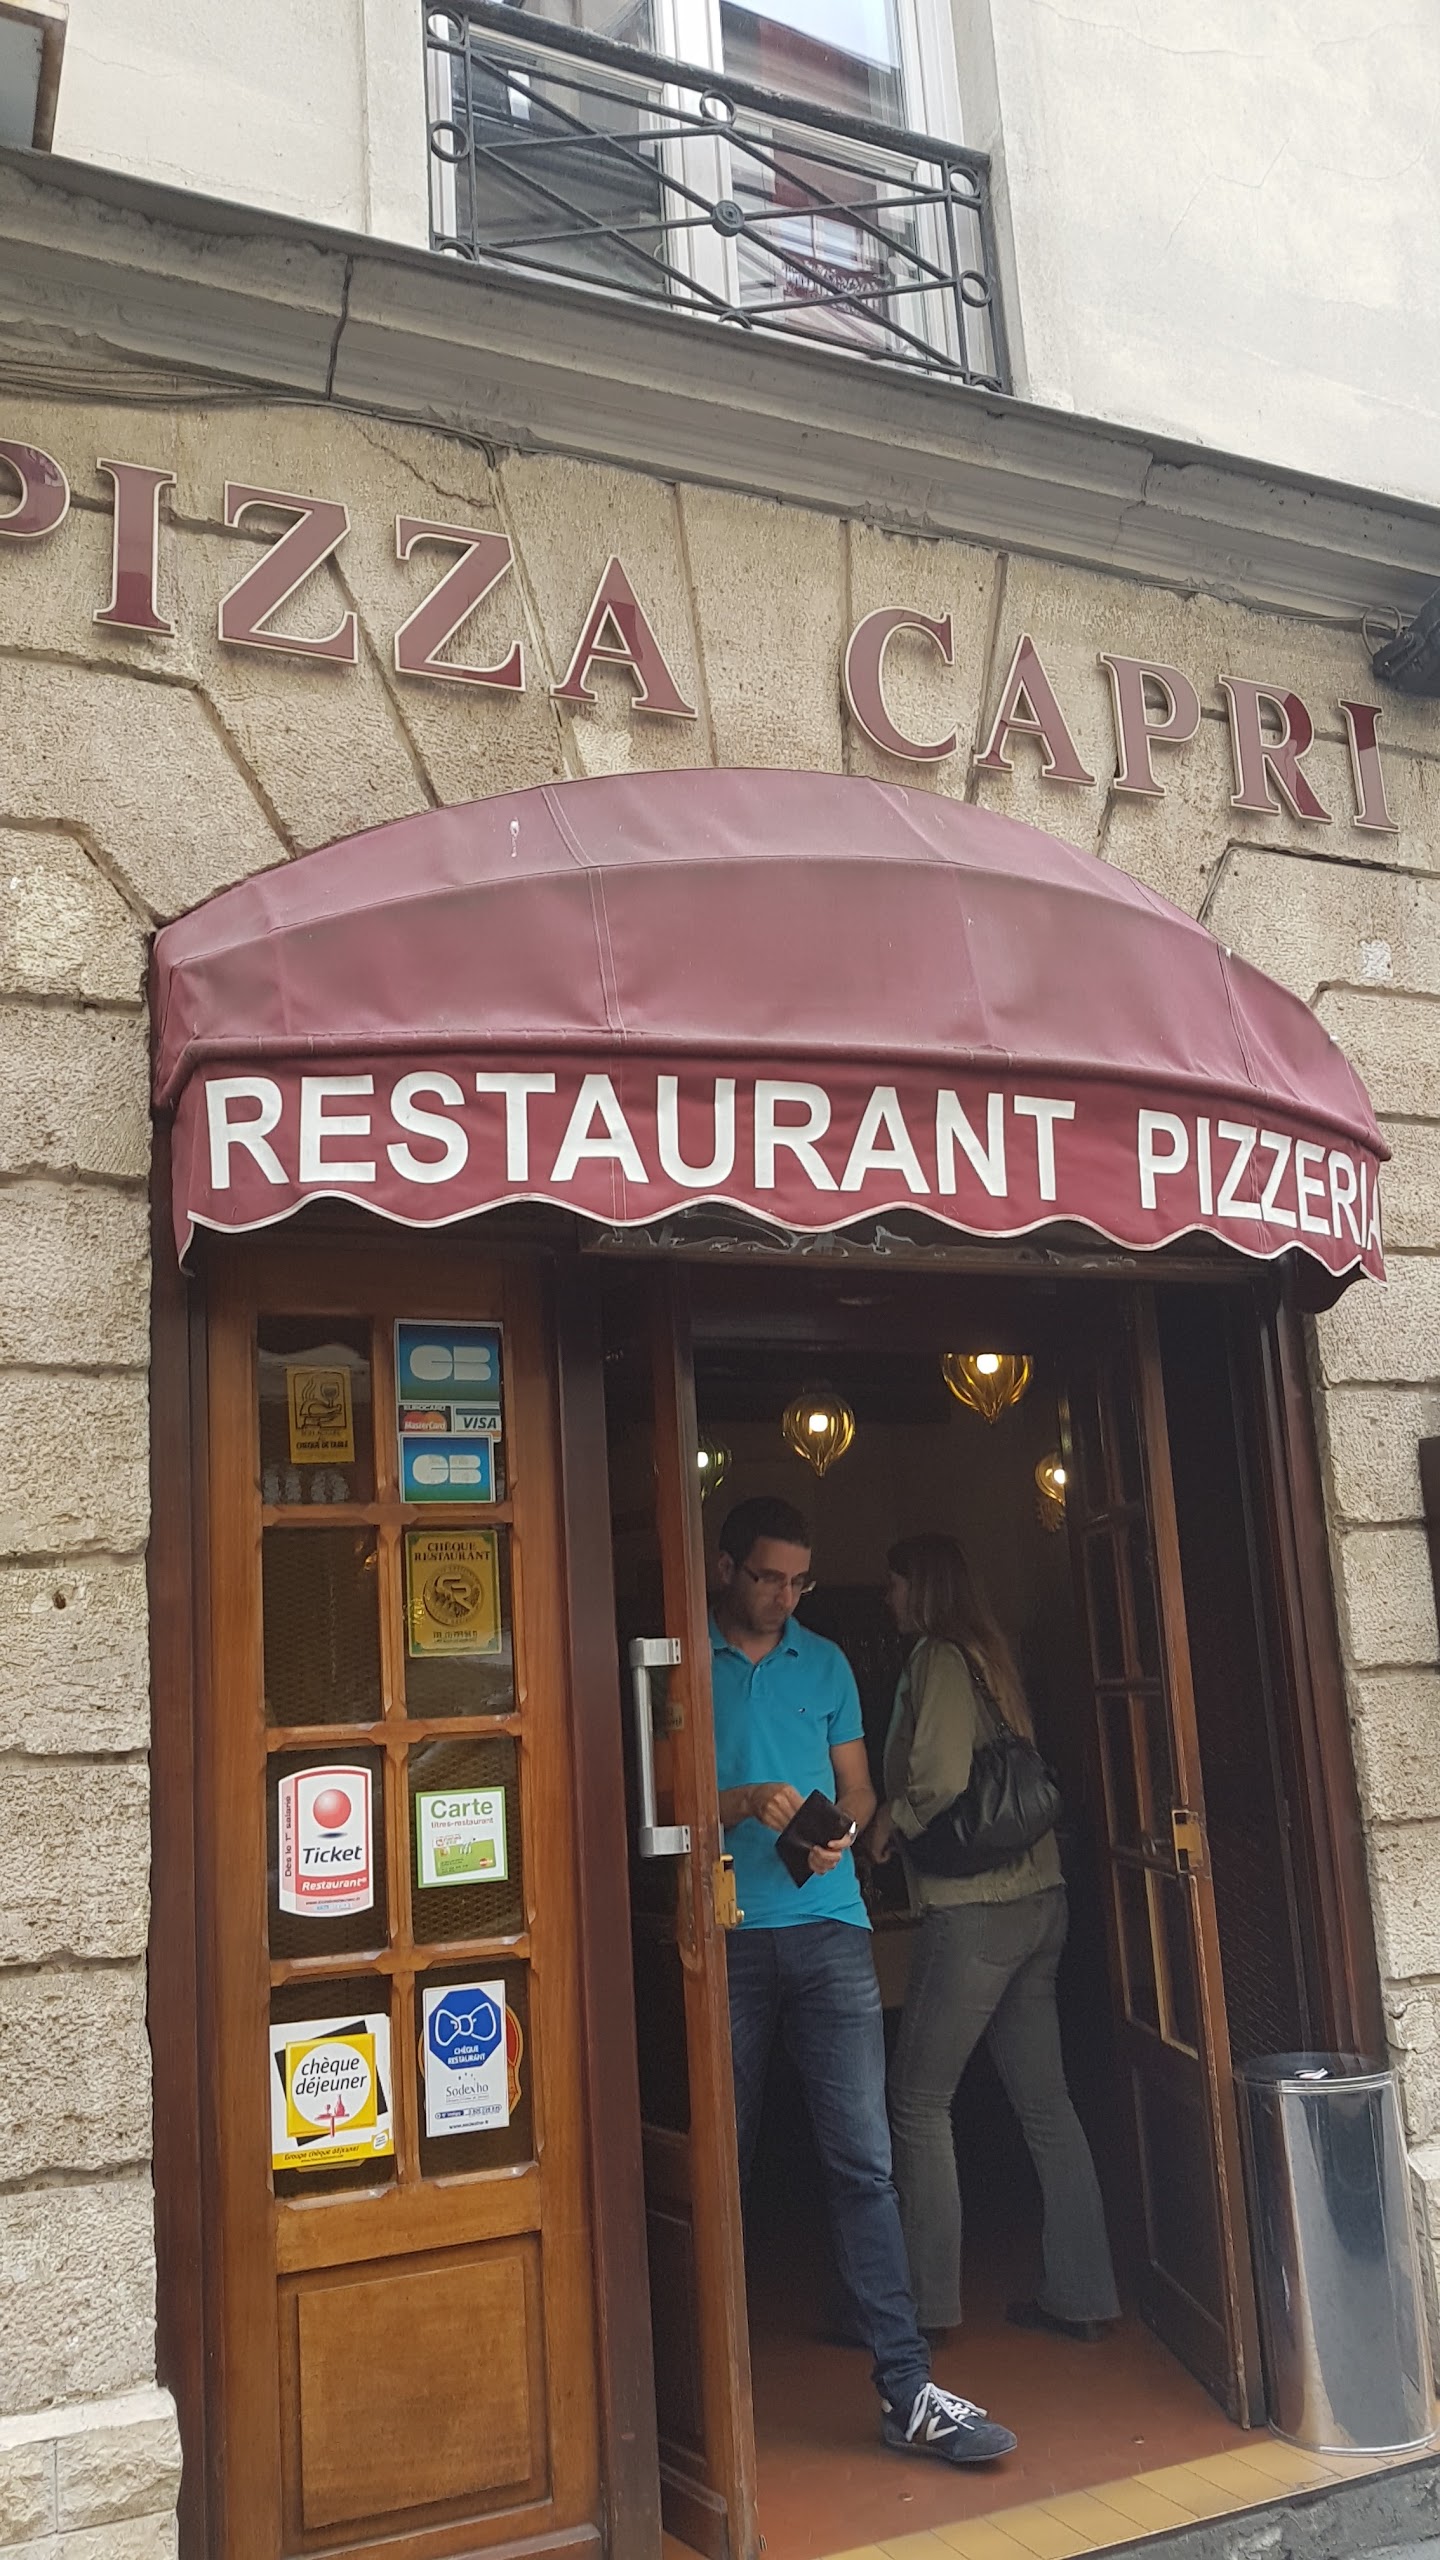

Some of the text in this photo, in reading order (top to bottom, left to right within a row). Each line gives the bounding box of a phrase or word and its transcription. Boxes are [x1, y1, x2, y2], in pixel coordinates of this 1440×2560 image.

[845, 606, 1400, 833] CAPRI
[205, 1071, 1076, 1202] RESTAURANT
[409, 1344, 491, 1381] CB
[463, 1417, 497, 1429] VISA
[412, 1453, 482, 1485] CB
[414, 1551, 491, 1561] RESTAURANT
[430, 1798, 493, 1819] Carte
[431, 1818, 494, 1829] titres-restaurant
[303, 1845, 363, 1864] Ticket
[301, 2056, 360, 2076] chèque
[295, 2076, 368, 2098] déjeuner
[446, 2082, 489, 2097] Sodexho
